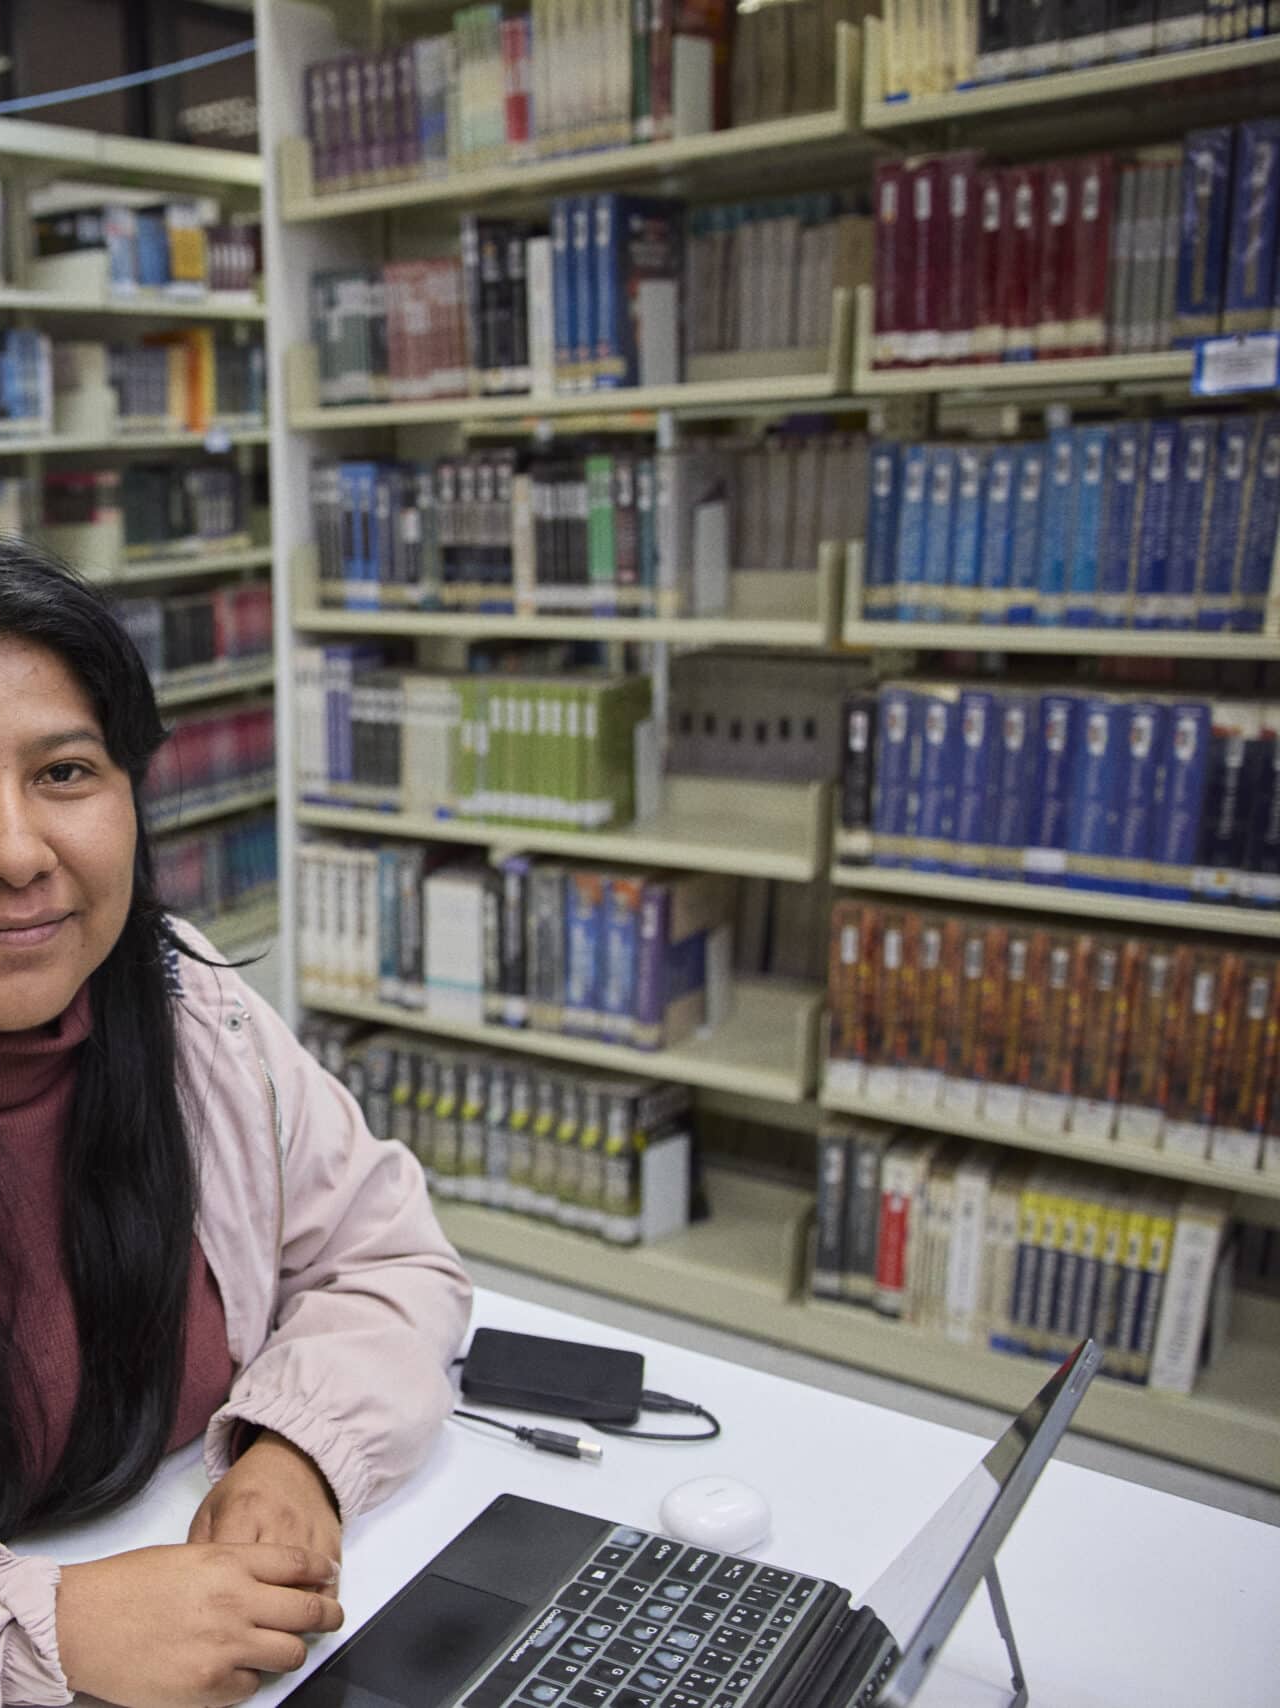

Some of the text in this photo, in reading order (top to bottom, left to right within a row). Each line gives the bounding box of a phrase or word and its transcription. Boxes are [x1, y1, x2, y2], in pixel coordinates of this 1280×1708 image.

[616, 1604, 629, 1612] X
[662, 1604, 673, 1612] S
[702, 1612, 716, 1621] W
[646, 1626, 659, 1634] D
[688, 1632, 700, 1641] E
[583, 1646, 596, 1654] V
[631, 1646, 643, 1654] F
[672, 1654, 685, 1663] R
[565, 1665, 578, 1673] B
[611, 1667, 624, 1676] G
[655, 1677, 669, 1685] T
[593, 1688, 607, 1697] H
[637, 1698, 651, 1706] Y
